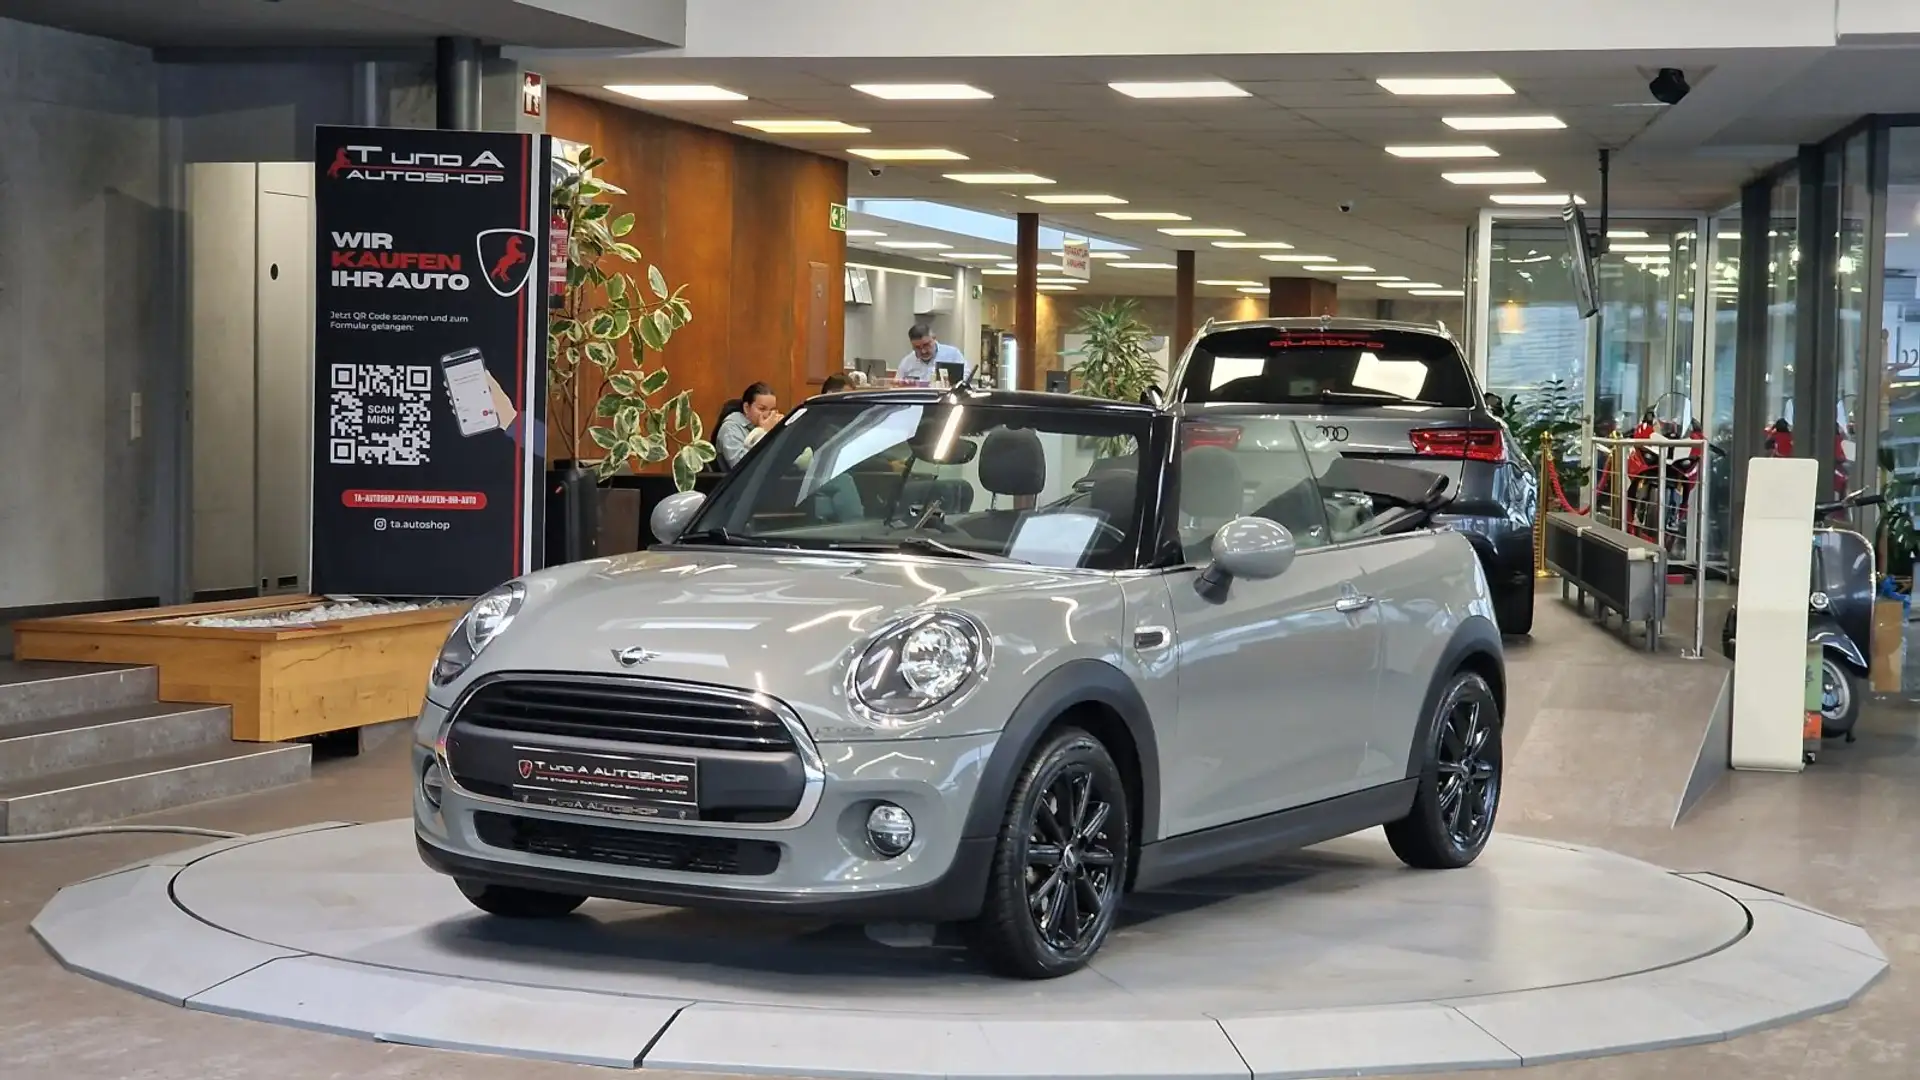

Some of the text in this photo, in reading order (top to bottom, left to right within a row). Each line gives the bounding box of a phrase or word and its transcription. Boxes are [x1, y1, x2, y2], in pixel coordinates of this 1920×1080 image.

[347, 145, 383, 163] T
[469, 150, 505, 168] A
[346, 169, 504, 184] AUTOSHOP
[331, 231, 393, 249] WIR
[331, 251, 461, 270] KAUFEN
[331, 271, 470, 291] IHR AUTO
[330, 311, 469, 323] Jetzt QR Code scannen und zum
[330, 321, 415, 332] Formular gelangen:
[1269, 339, 1385, 349] quattro
[367, 404, 395, 414] SCAN
[367, 415, 395, 425] MICH
[390, 520, 451, 531] ta.autoshop
[534, 760, 546, 770] T
[578, 765, 589, 774] A
[593, 766, 689, 783] AUTOSHOP
[573, 800, 583, 809] A
[587, 801, 659, 815] AUTOSHOP
